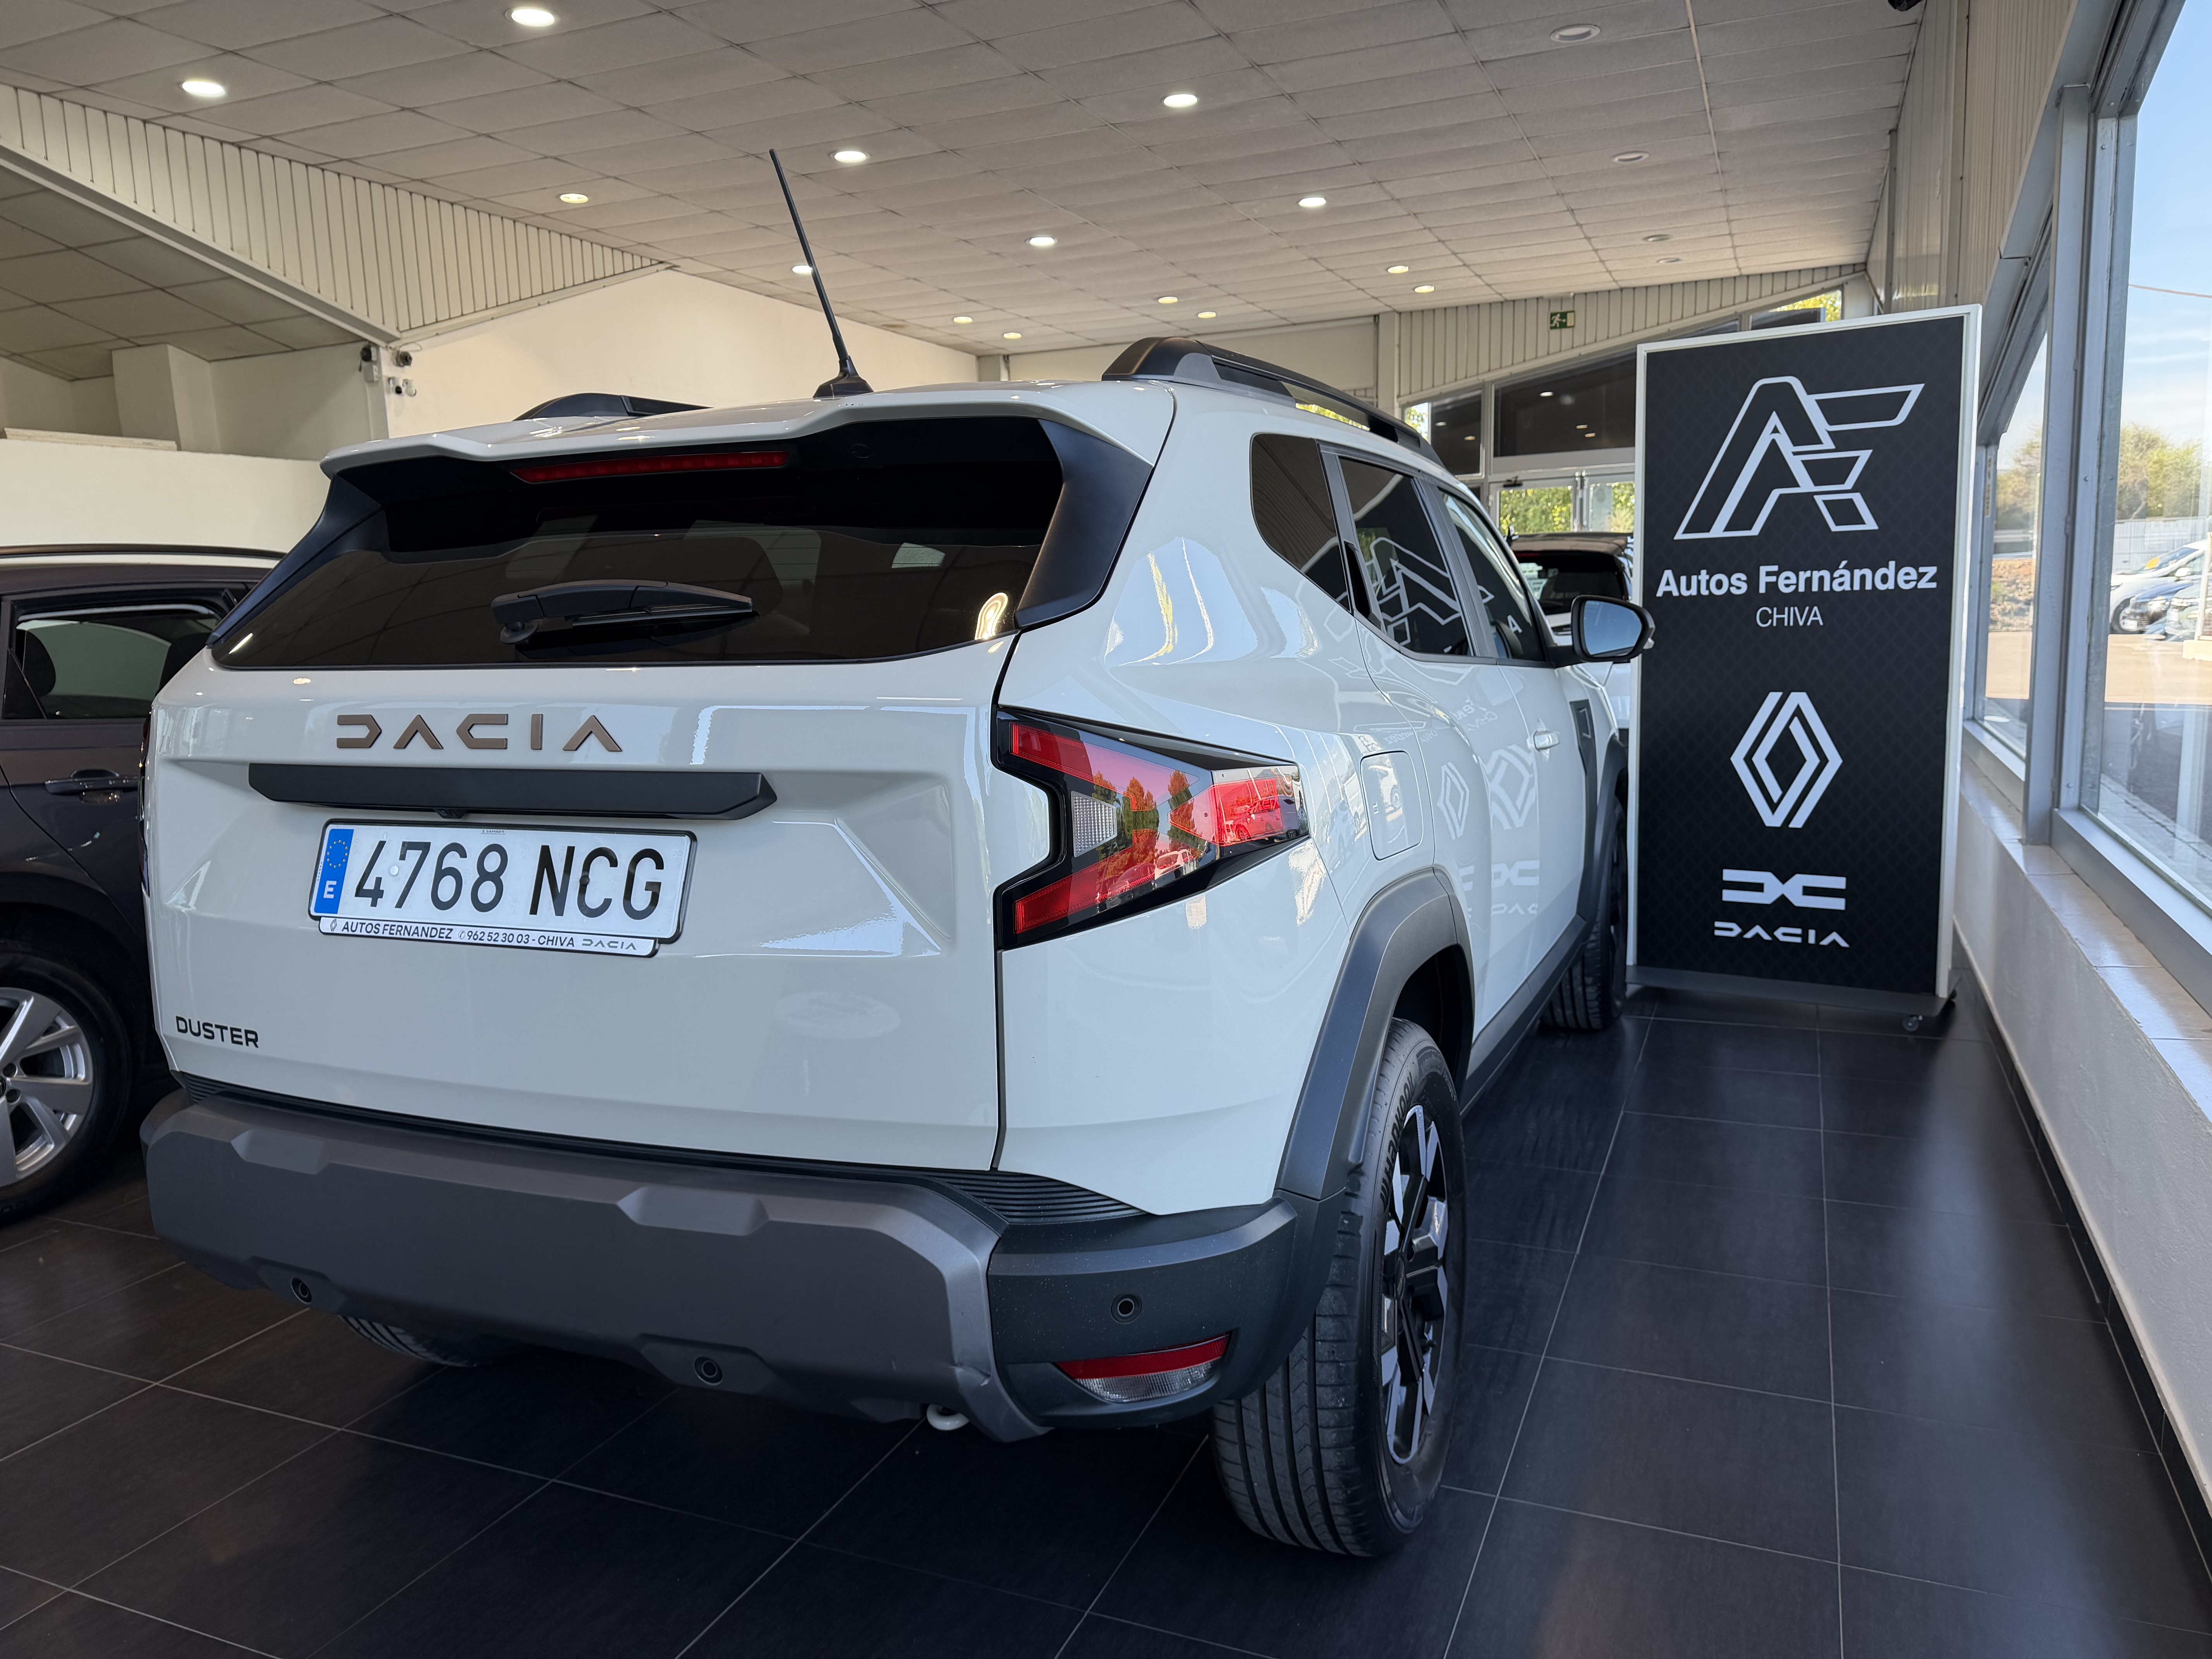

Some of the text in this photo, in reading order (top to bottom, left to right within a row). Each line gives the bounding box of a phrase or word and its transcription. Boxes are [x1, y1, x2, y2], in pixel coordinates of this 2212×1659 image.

[1656, 560, 1937, 597] Autos Fernández
[1755, 606, 1823, 627] CHIVA
[337, 714, 622, 752] DACIA
[323, 881, 335, 899] E
[354, 841, 664, 920] 4768 NCG
[342, 921, 380, 934] AUTOS
[382, 924, 453, 939] FERNANDEZ
[467, 930, 484, 941] 962
[486, 931, 499, 942] 52
[501, 933, 514, 943] 30
[516, 934, 529, 944] 03
[538, 935, 575, 947] CHIVA
[582, 938, 637, 950] DACIA
[1714, 921, 1850, 948] DACIA
[176, 1016, 259, 1048] DUSTER
